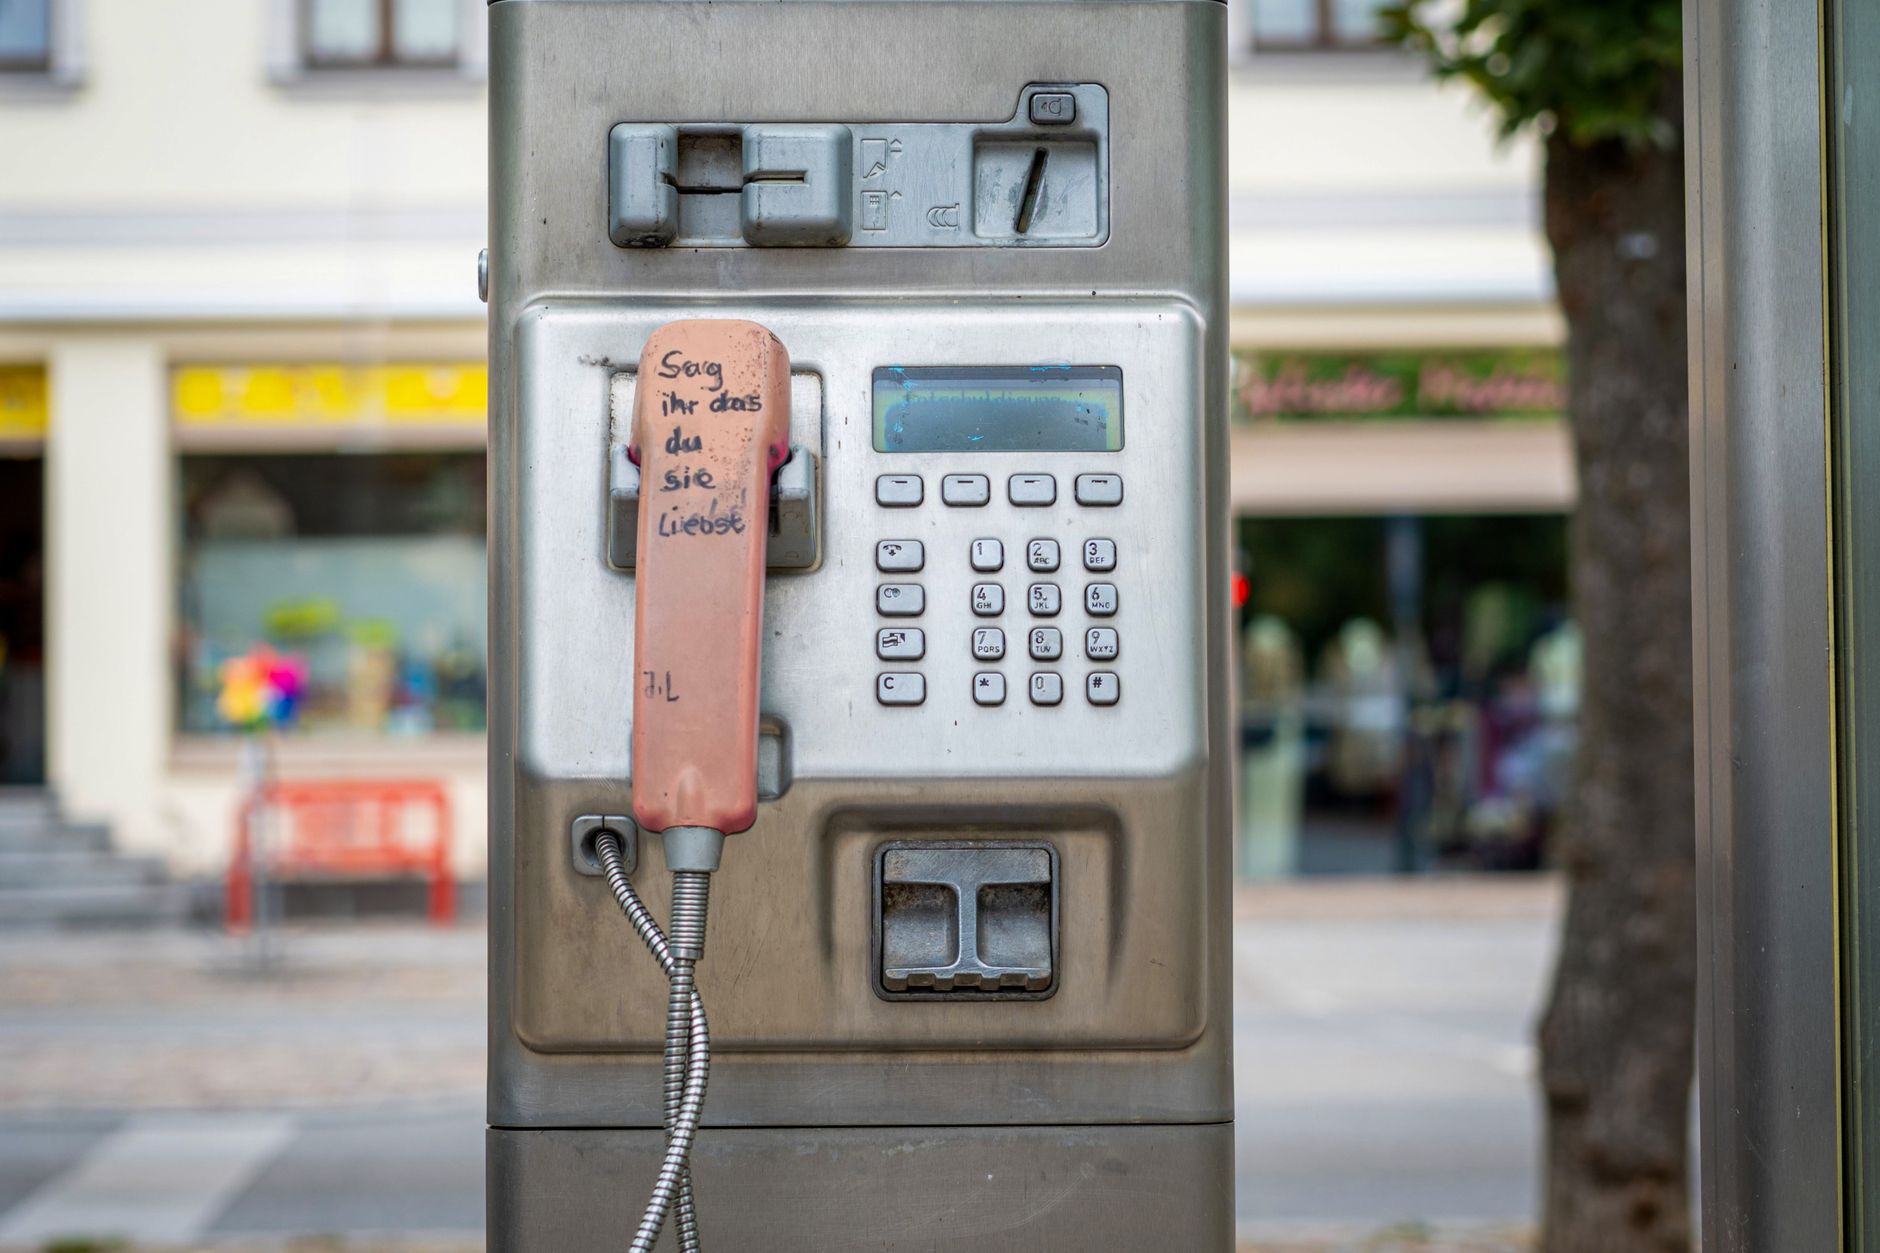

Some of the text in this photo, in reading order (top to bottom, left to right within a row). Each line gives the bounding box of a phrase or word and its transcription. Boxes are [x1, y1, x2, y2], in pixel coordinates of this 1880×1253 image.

[658, 350, 724, 392] Sag
[661, 390, 763, 416] ihr das
[665, 426, 703, 454] du
[660, 466, 716, 492] sie
[976, 542, 983, 556] 1
[1033, 542, 1042, 557] 2
[1088, 542, 1098, 557] 3
[976, 587, 987, 601] 4
[1033, 587, 1043, 601] 5
[1091, 587, 1100, 601] 6
[977, 631, 987, 645] 7
[1035, 631, 1045, 645] 8
[1091, 631, 1100, 645] 9
[883, 676, 895, 690] C
[1035, 676, 1044, 690] 0
[1092, 676, 1103, 689] #
